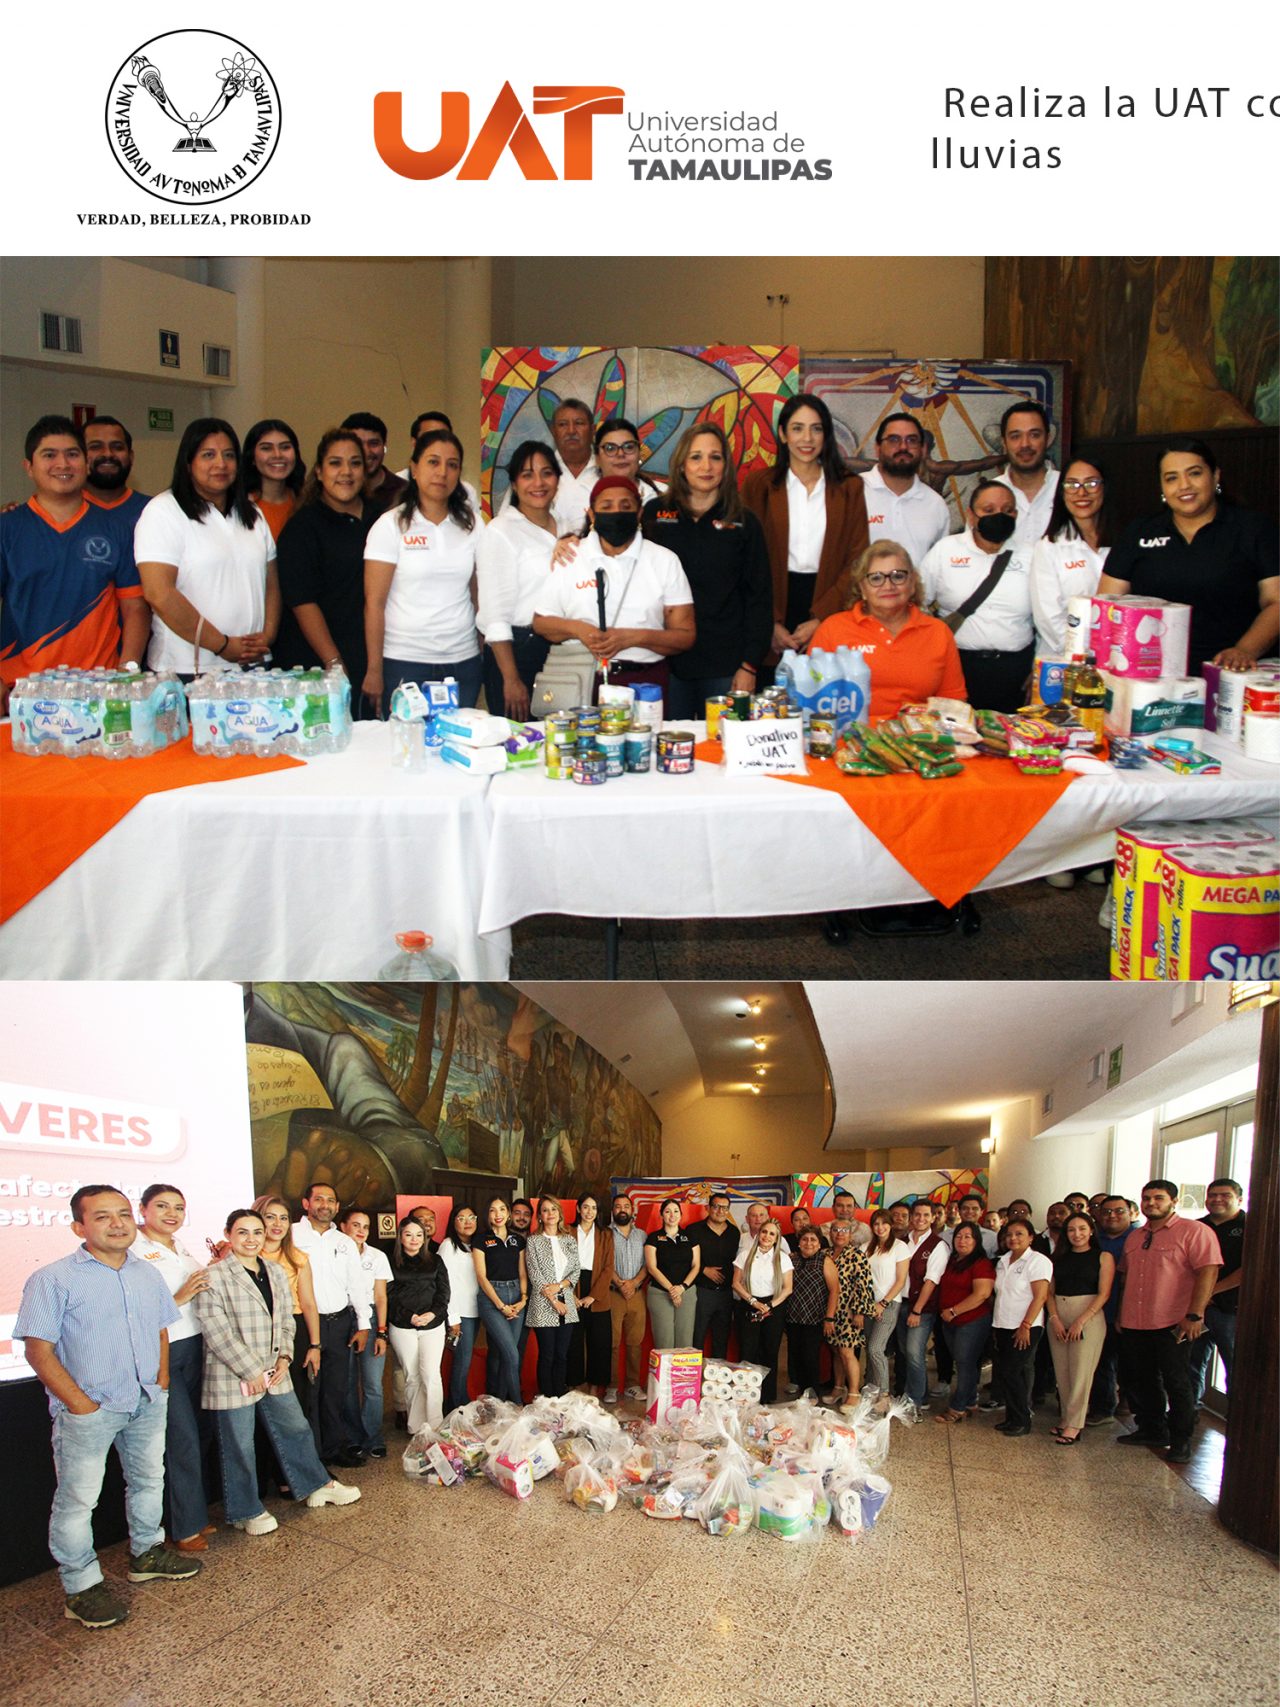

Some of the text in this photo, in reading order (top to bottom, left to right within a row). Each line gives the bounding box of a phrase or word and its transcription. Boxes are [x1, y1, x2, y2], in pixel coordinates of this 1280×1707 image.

[403, 535, 428, 546] UAT
[1139, 536, 1171, 548] UAT
[950, 557, 971, 565] UAT
[1065, 559, 1086, 569] UAT
[817, 688, 857, 714] ciel
[1144, 705, 1185, 717] Linnette
[42, 716, 73, 729] AGUA
[234, 715, 268, 727] AGUA
[746, 729, 798, 747] Donativo
[762, 743, 788, 758] UAT
[1116, 840, 1133, 879] 48
[1162, 863, 1176, 906] 48
[1202, 886, 1280, 904] MEGA PA
[1119, 886, 1135, 979] MEGA PACK
[1171, 914, 1181, 956] PACK
[1204, 944, 1280, 981] Sua
[144, 1251, 161, 1261] UAT
